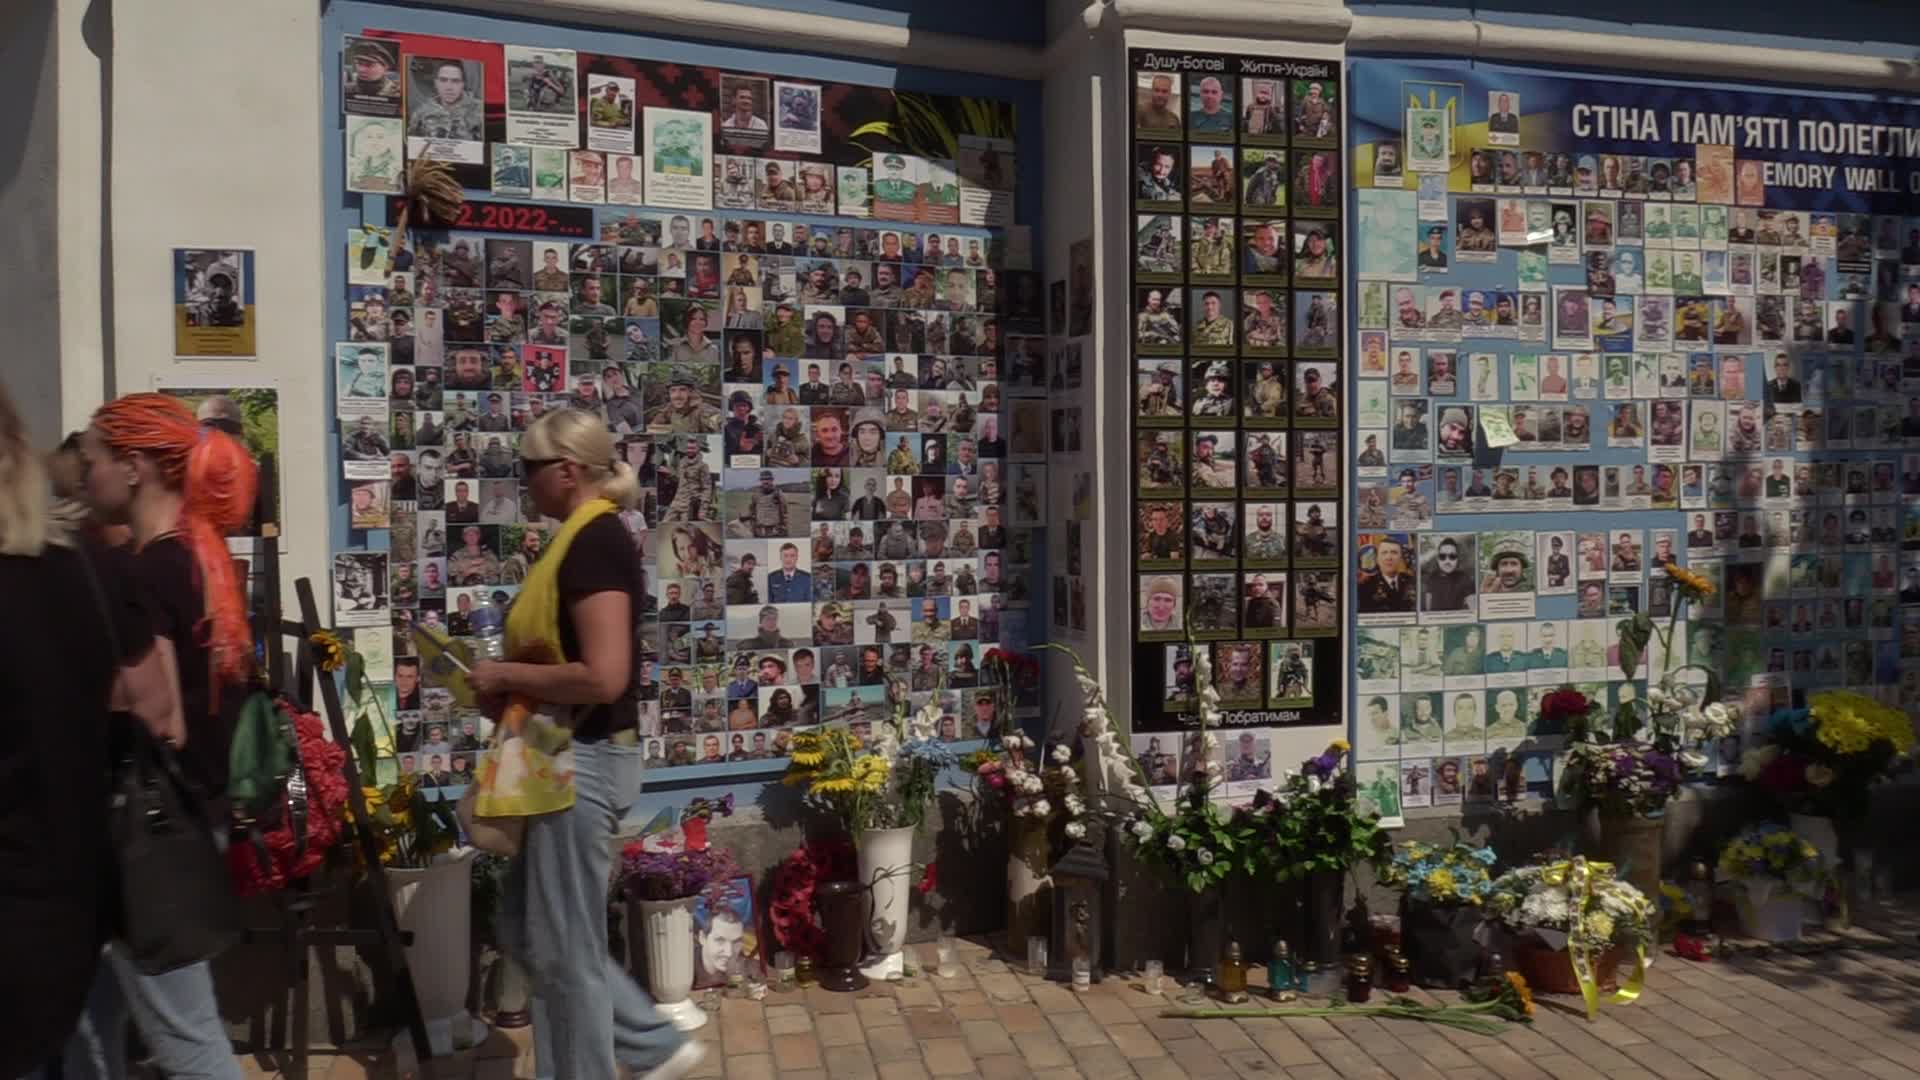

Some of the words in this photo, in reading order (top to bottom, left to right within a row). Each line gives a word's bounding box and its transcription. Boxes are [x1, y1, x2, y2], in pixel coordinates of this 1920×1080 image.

[1572, 104, 1660, 141] СТІНА
[1763, 161, 1836, 189] EMORY
[1844, 167, 1902, 192] WALL
